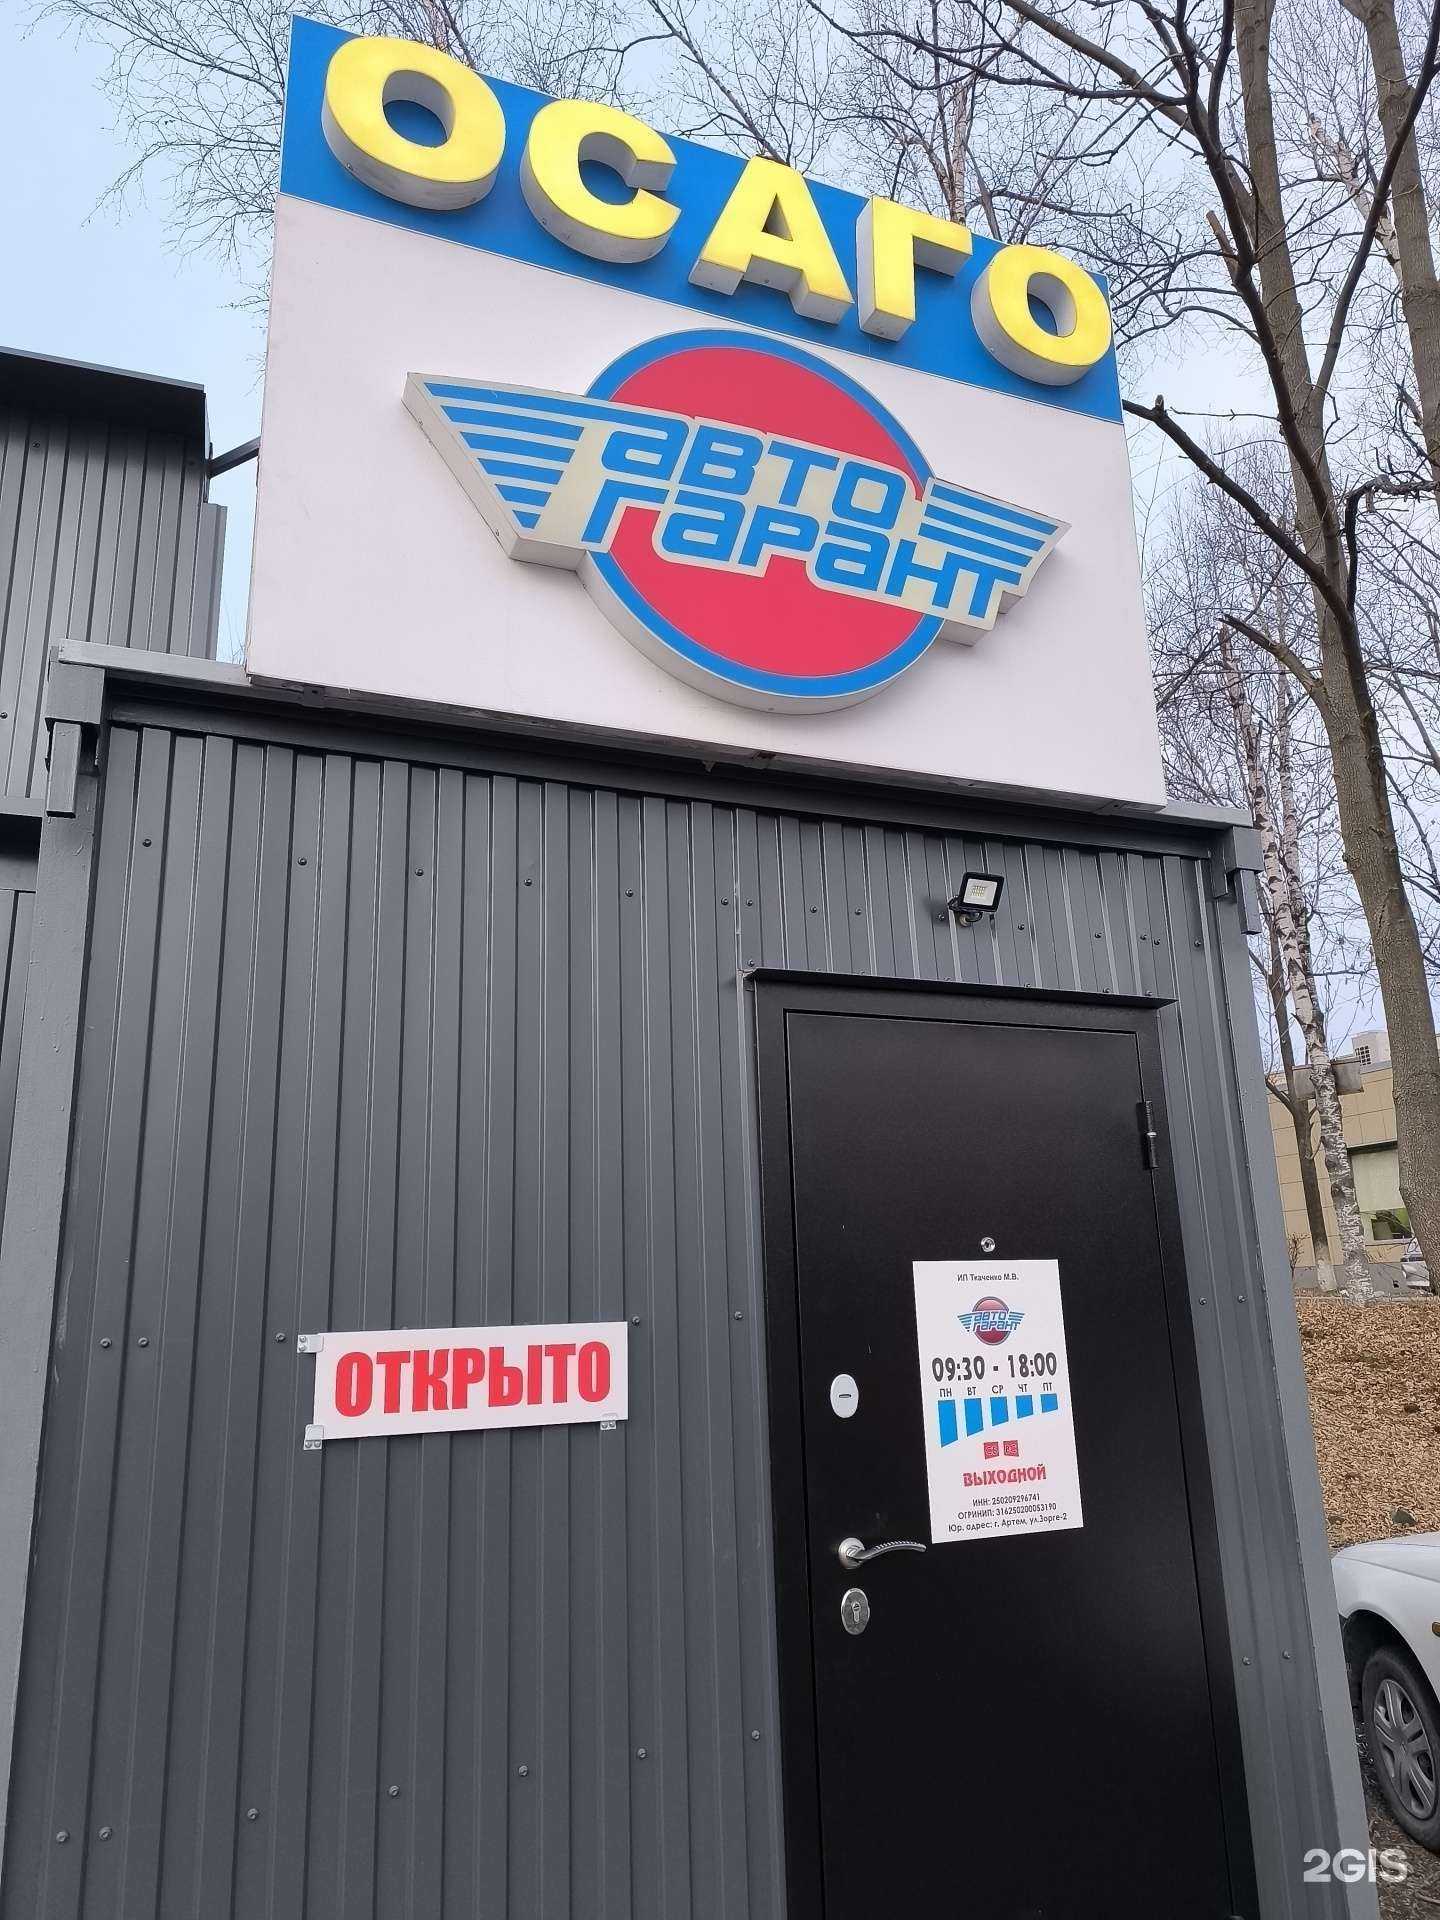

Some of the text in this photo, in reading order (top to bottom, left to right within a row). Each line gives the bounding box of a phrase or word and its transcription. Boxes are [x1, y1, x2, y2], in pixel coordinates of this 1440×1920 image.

[322, 35, 1113, 386] ОСАГО
[957, 1273, 1019, 1282] ИП Ткаченко М.В.
[932, 1356, 985, 1382] 09:30
[1007, 1352, 1057, 1378] 18:00
[335, 1341, 611, 1417] ОТКРЫТО
[940, 1382, 1053, 1398] ПН ВТ СР ЧТ ПТ
[963, 1464, 1046, 1487] ВЫХОДНОЙ
[972, 1498, 991, 1507] ИНН:
[948, 1523, 964, 1533] Юр.
[966, 1521, 993, 1532] адрес:
